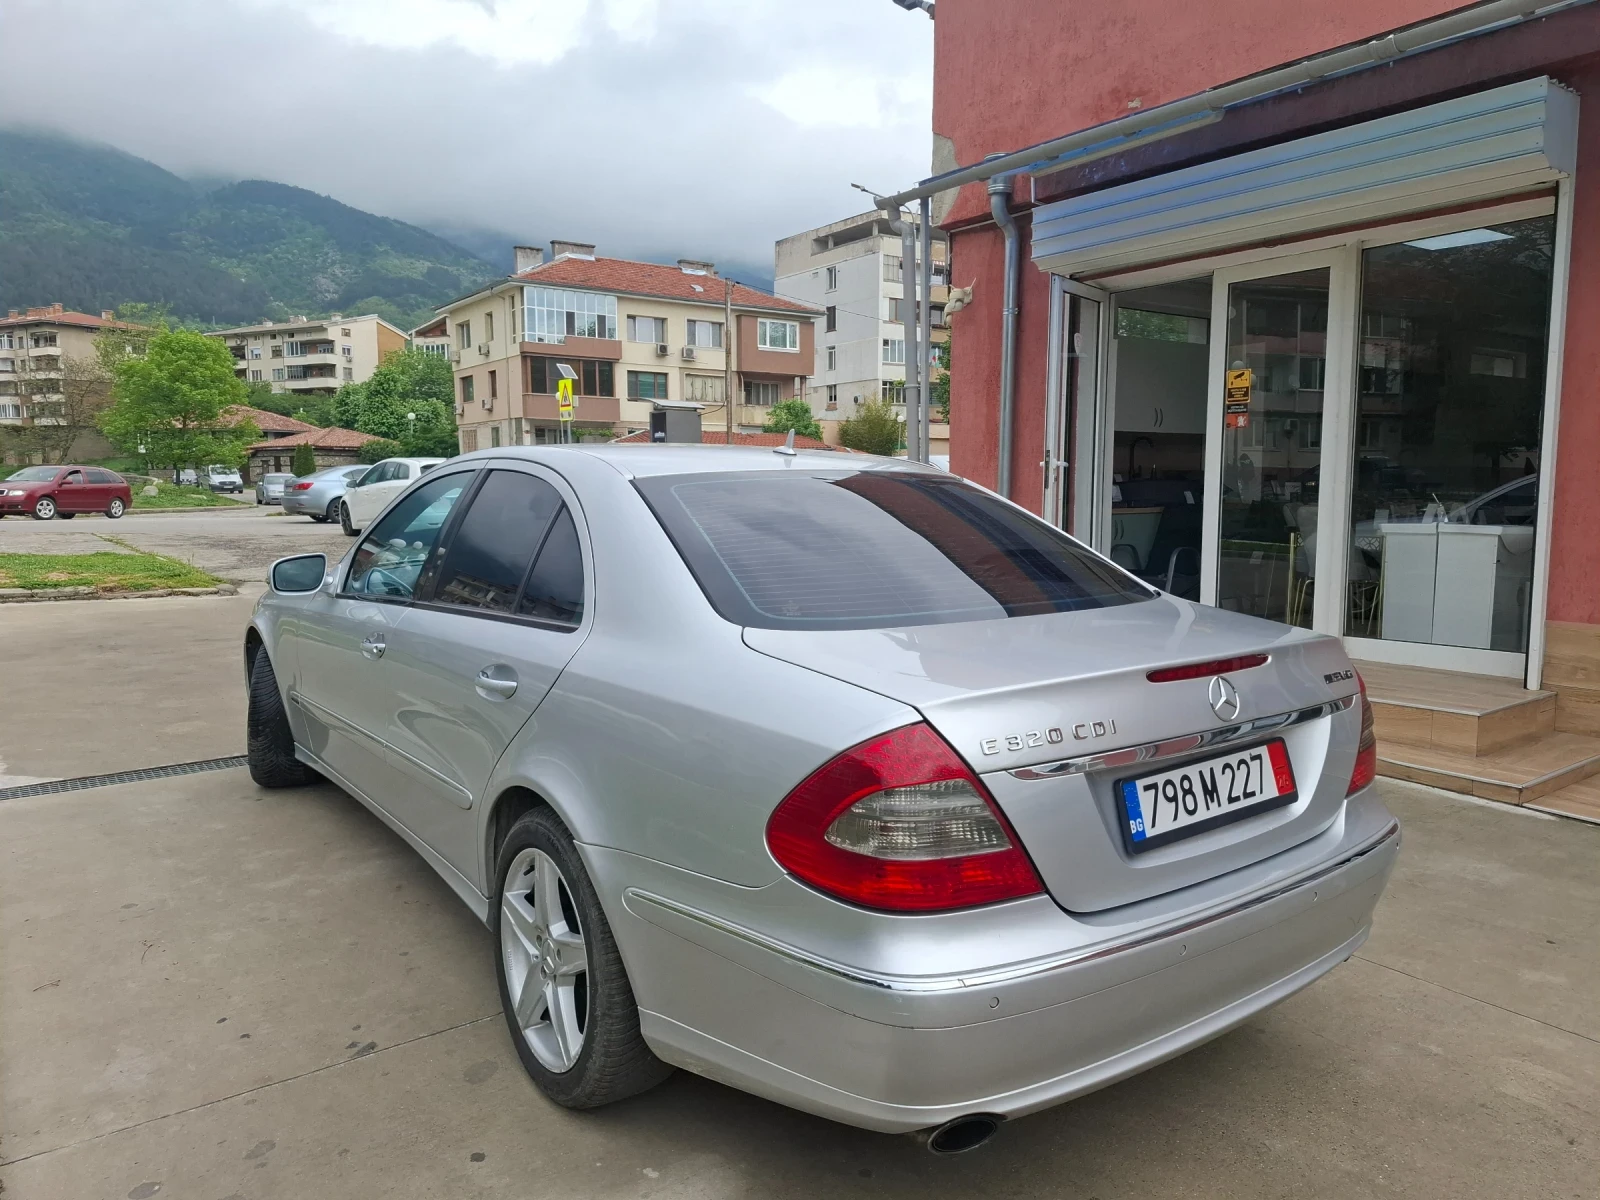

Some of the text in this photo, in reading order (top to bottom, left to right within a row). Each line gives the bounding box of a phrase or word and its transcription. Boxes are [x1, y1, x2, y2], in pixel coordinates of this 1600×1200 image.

[980, 718, 1117, 756] E 320 CDI
[1129, 818, 1144, 834] BG
